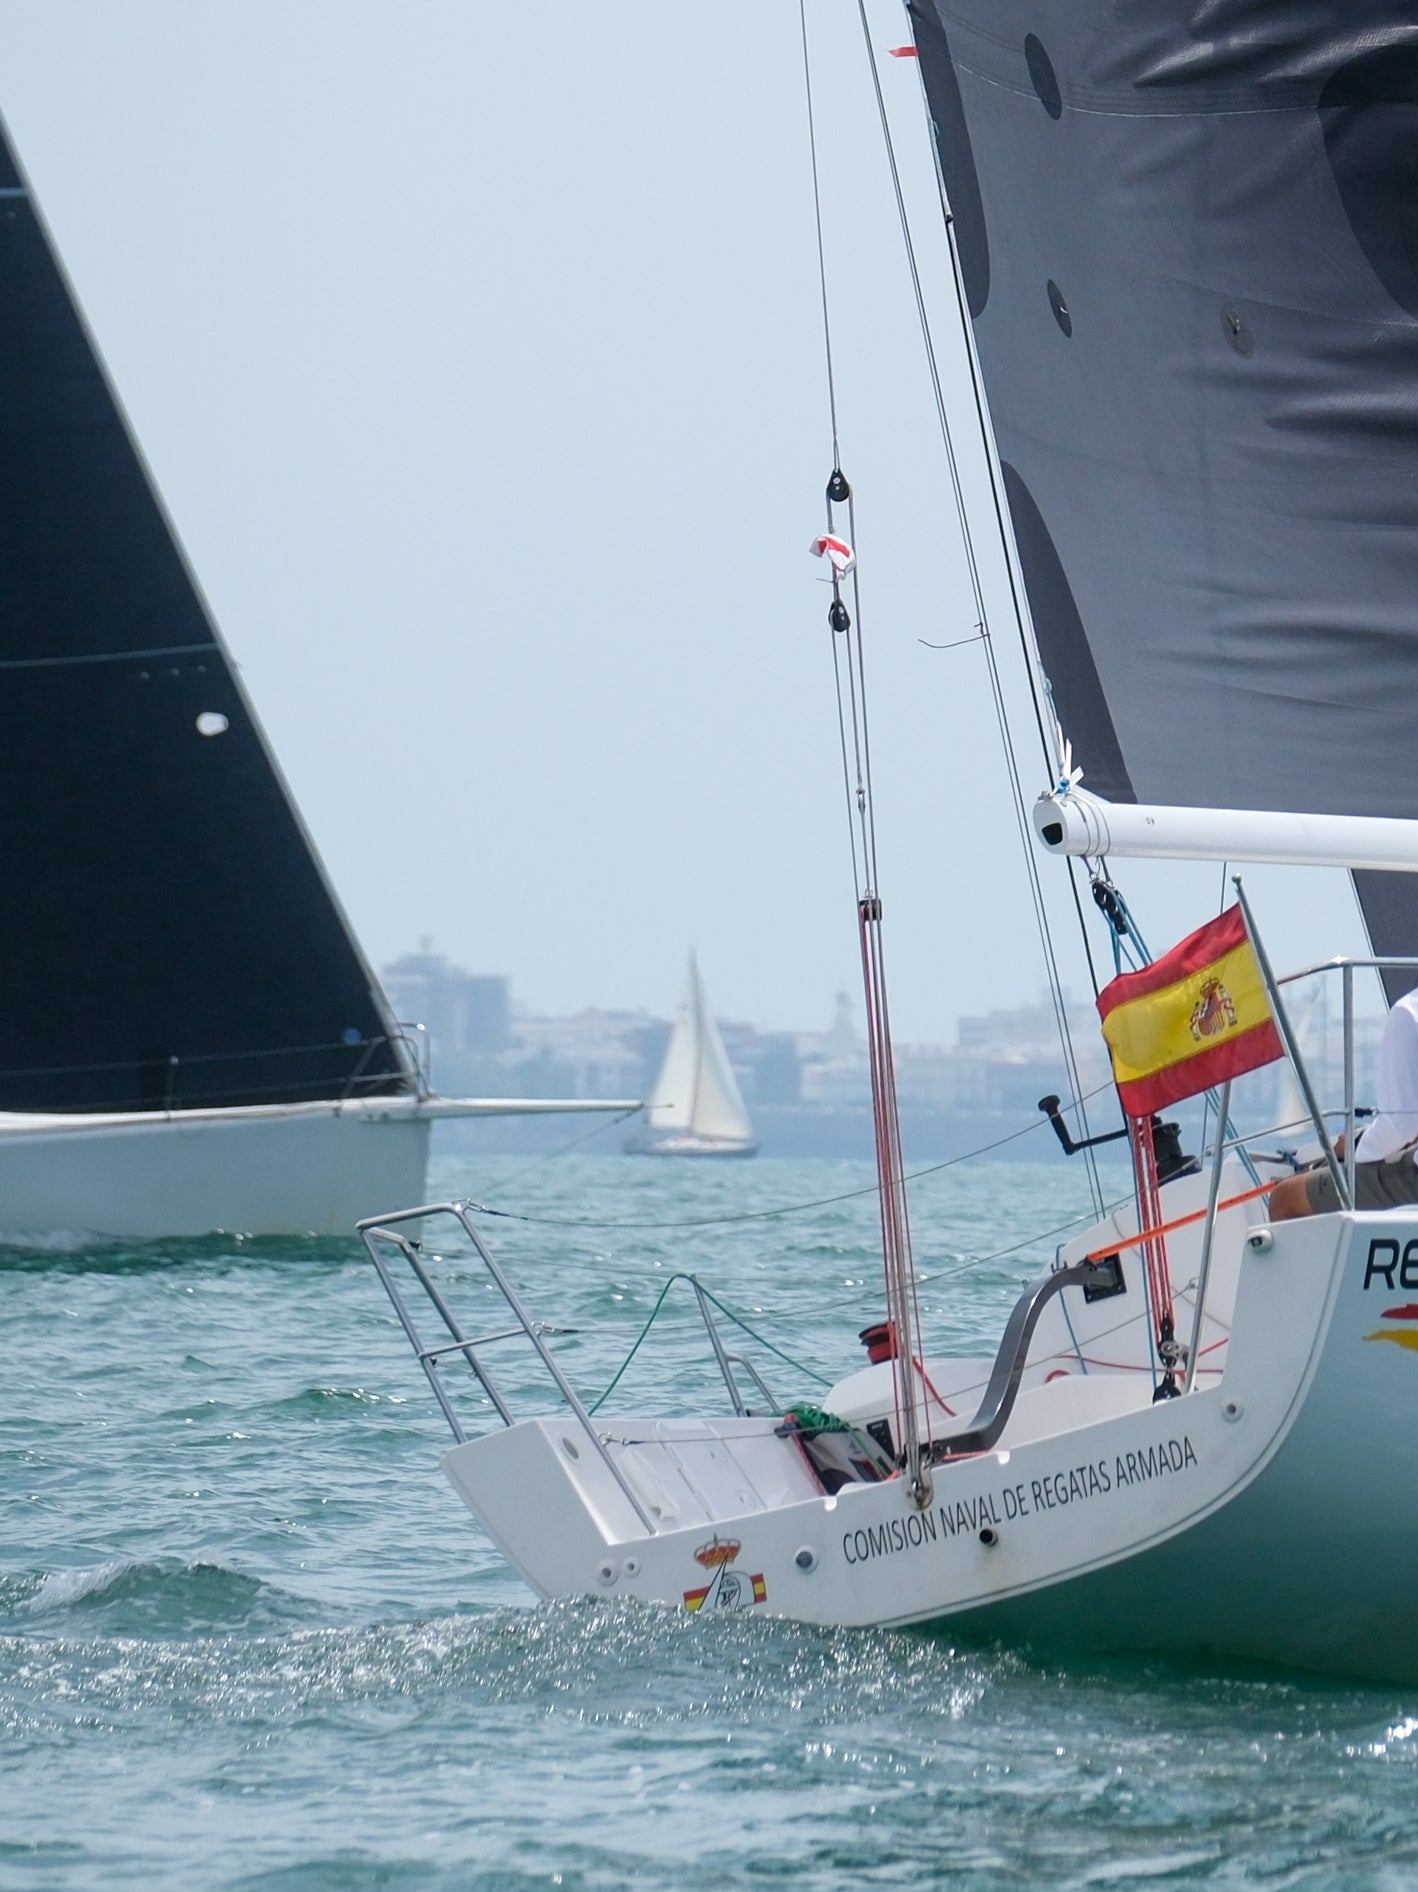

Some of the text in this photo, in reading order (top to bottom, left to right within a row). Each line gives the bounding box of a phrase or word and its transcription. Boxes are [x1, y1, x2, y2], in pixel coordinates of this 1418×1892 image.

[842, 1436, 1198, 1564] COMISION NAVAL DE REGATAS ARMADA
